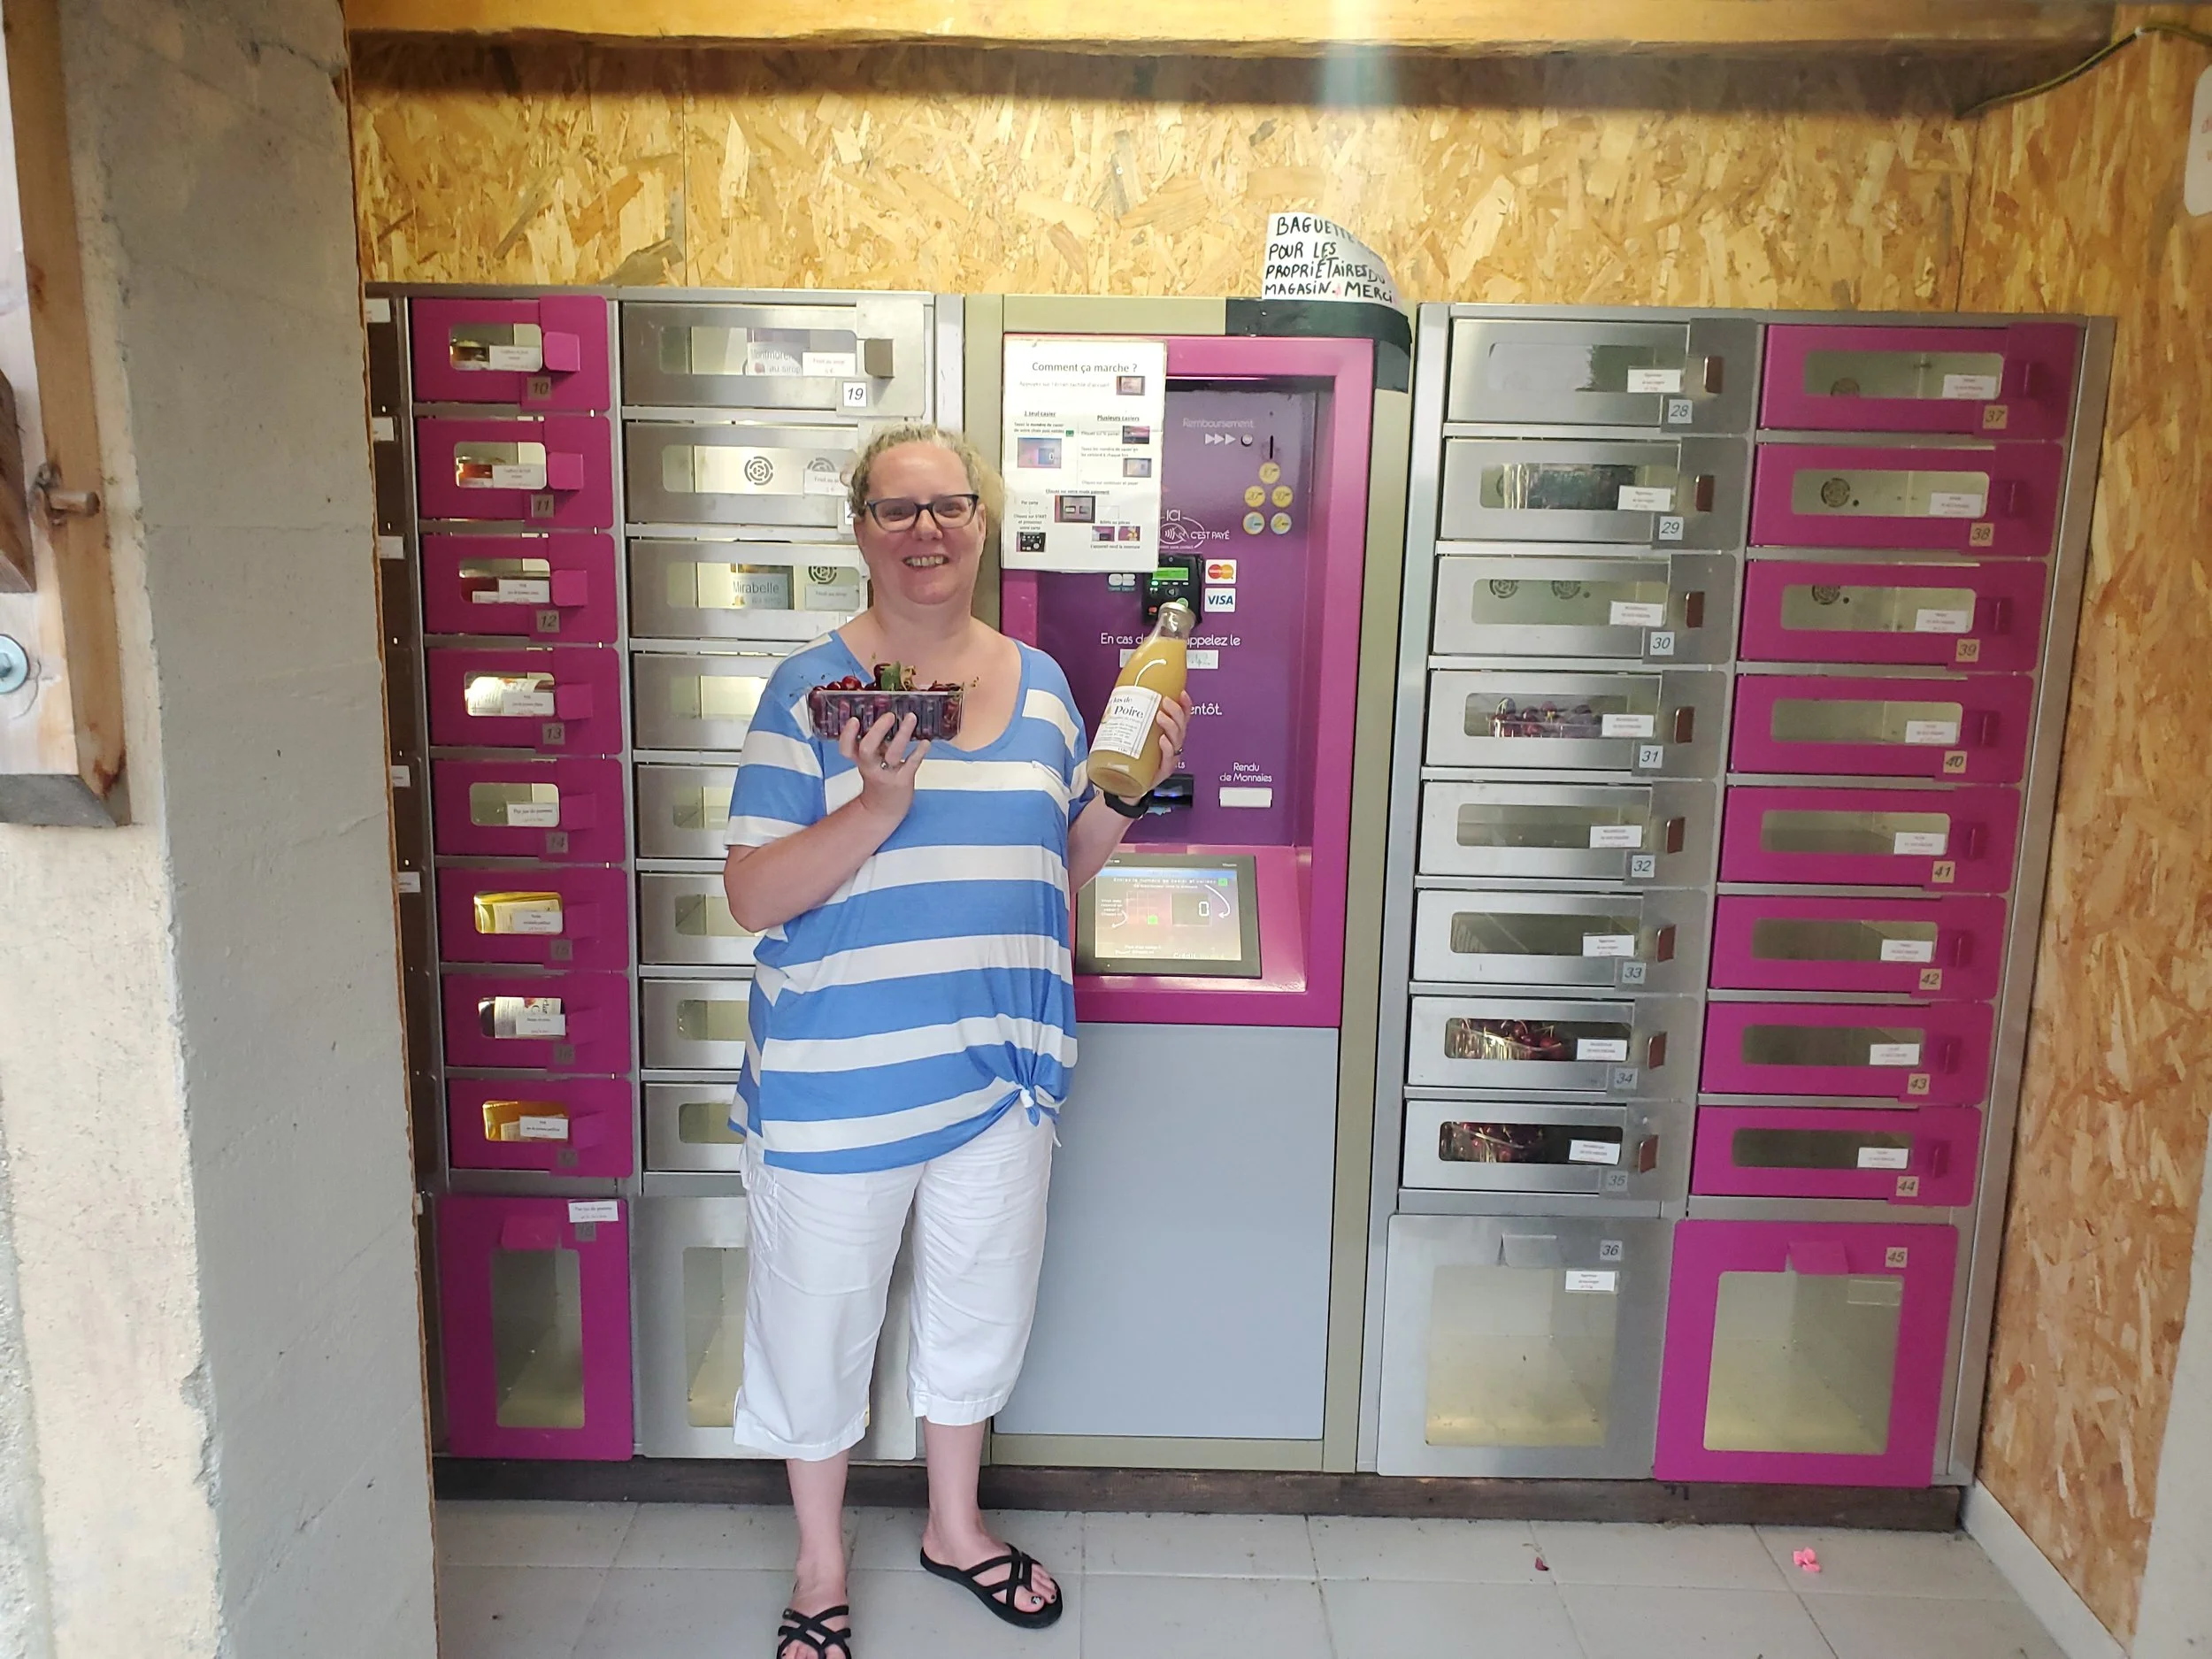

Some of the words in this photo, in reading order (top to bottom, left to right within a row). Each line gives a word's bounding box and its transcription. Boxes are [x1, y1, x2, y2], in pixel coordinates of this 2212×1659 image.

[1269, 242, 1303, 261] POUR
[1314, 242, 1336, 259] LES
[1032, 362, 1078, 373] Comment
[1080, 365, 1091, 374] ça
[1094, 363, 1129, 373] marche
[1133, 363, 1138, 373] ?
[533, 382, 549, 395] 10
[847, 388, 864, 401] 19
[1671, 403, 1689, 418] 28
[1985, 410, 2005, 423] 37
[1183, 418, 1254, 429] Remboursement
[536, 499, 550, 512] 11
[1166, 510, 1181, 521] ICI
[1662, 521, 1680, 534] 29
[1211, 529, 1230, 540] PAYÉ
[1972, 527, 1991, 541] 38
[733, 580, 780, 594] Mirabelle
[1208, 595, 1233, 605] VISA
[541, 615, 557, 626] 12
[1101, 633, 1114, 644] En
[1116, 635, 1133, 645] cas
[1135, 633, 1144, 644] d
[1230, 634, 1241, 646] le
[1653, 636, 1671, 649] 30
[1958, 644, 1977, 657] 39
[1115, 705, 1144, 718] Poire
[547, 728, 562, 740] 13
[1642, 750, 1659, 763] 31
[1946, 756, 1964, 767] 40
[1233, 762, 1260, 772] Rendu
[1219, 772, 1232, 782] de
[1233, 772, 1272, 783] Monnaies
[1633, 860, 1651, 872] 32
[1934, 866, 1951, 878] 41
[1198, 901, 1210, 917] 0
[1624, 967, 1642, 979] 33
[1922, 973, 1939, 985] 42
[1617, 1072, 1633, 1084] 34
[1910, 1079, 1927, 1089] 43
[1609, 1175, 1626, 1187] 35
[1899, 1181, 1916, 1192] 44
[1602, 1245, 1619, 1256] 36
[1888, 1252, 1904, 1263] 45
